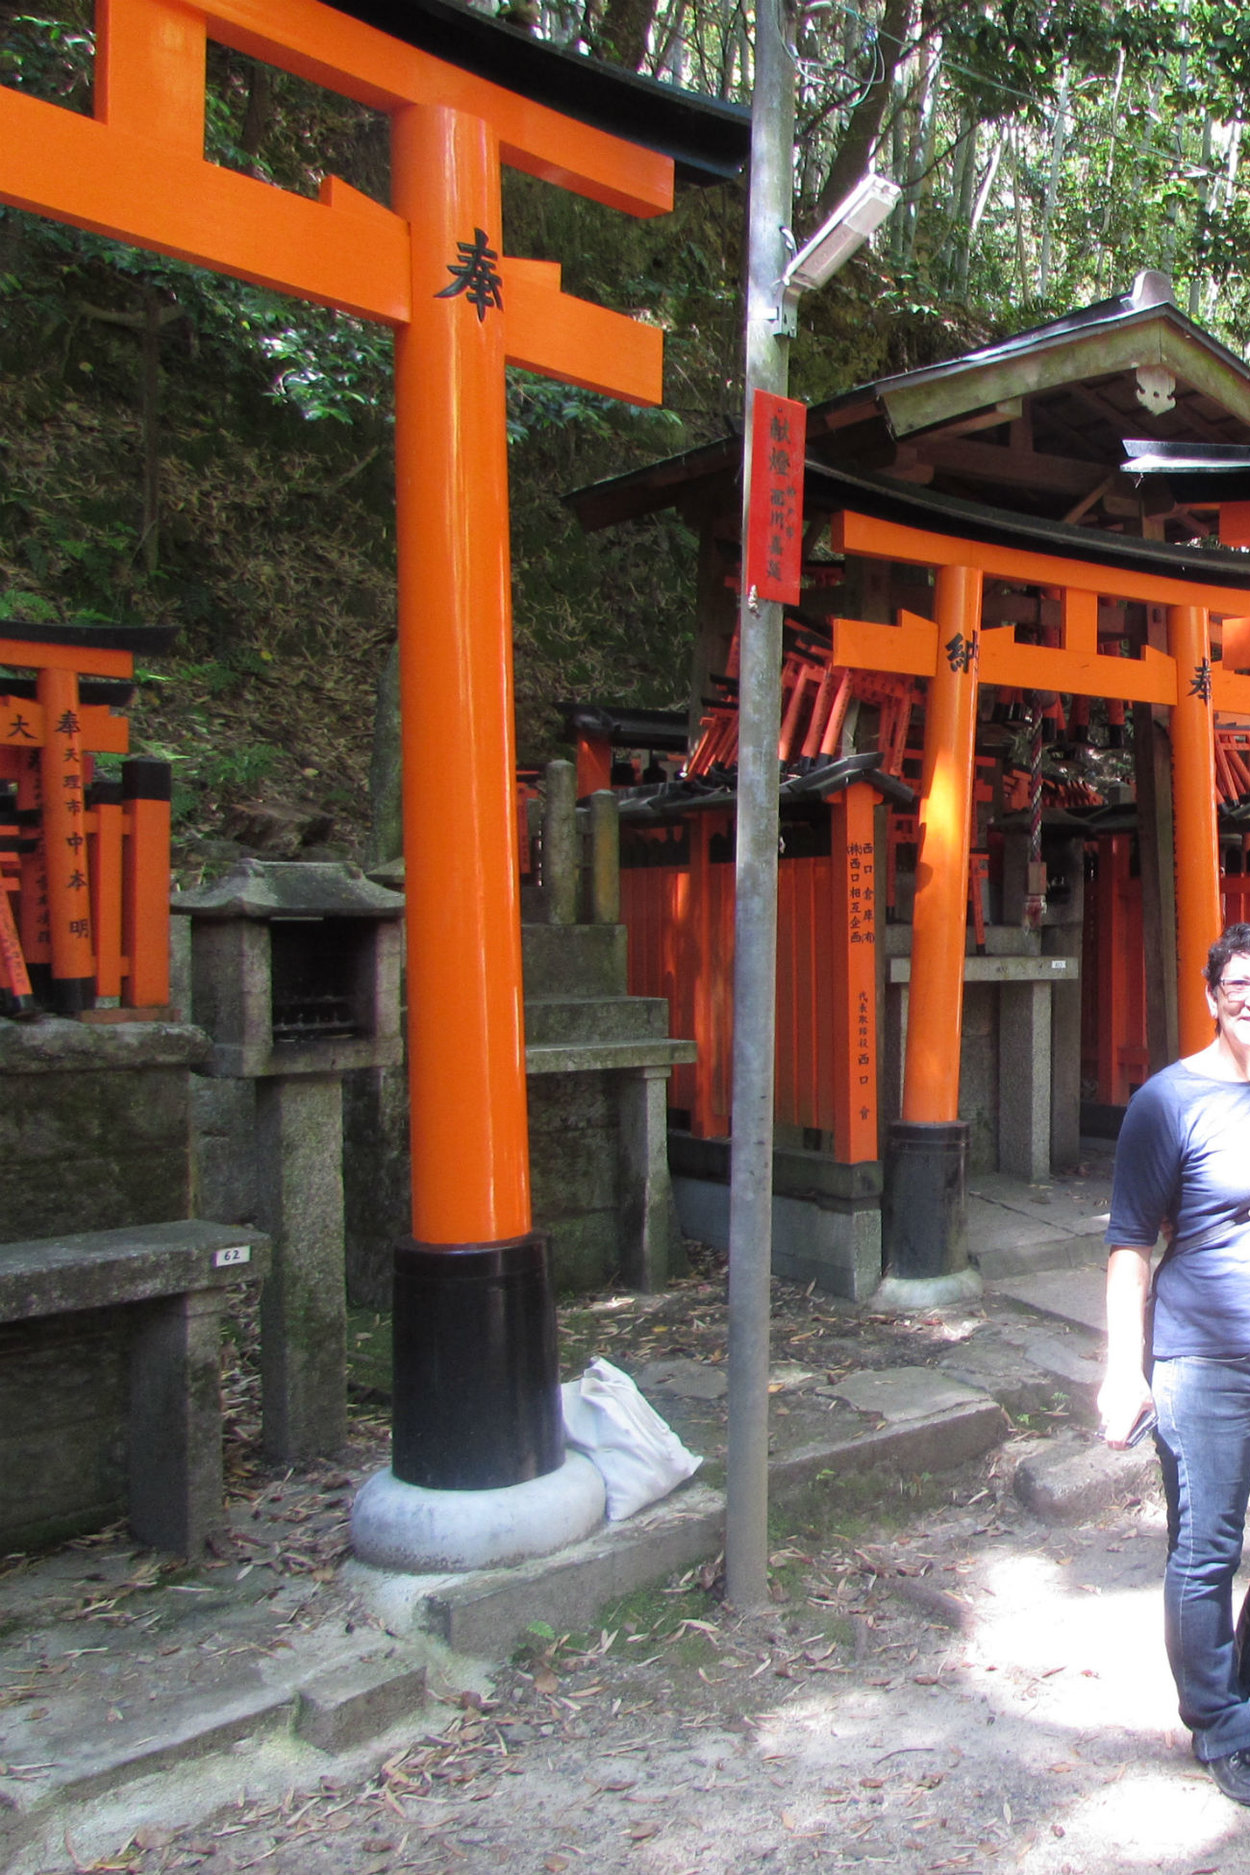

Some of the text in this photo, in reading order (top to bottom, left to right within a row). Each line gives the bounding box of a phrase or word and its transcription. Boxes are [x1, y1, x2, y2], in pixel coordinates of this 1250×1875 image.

[433, 227, 504, 322] 奉
[7, 714, 38, 740] 大
[55, 709, 82, 740] 奉
[224, 1249, 241, 1261] 62
